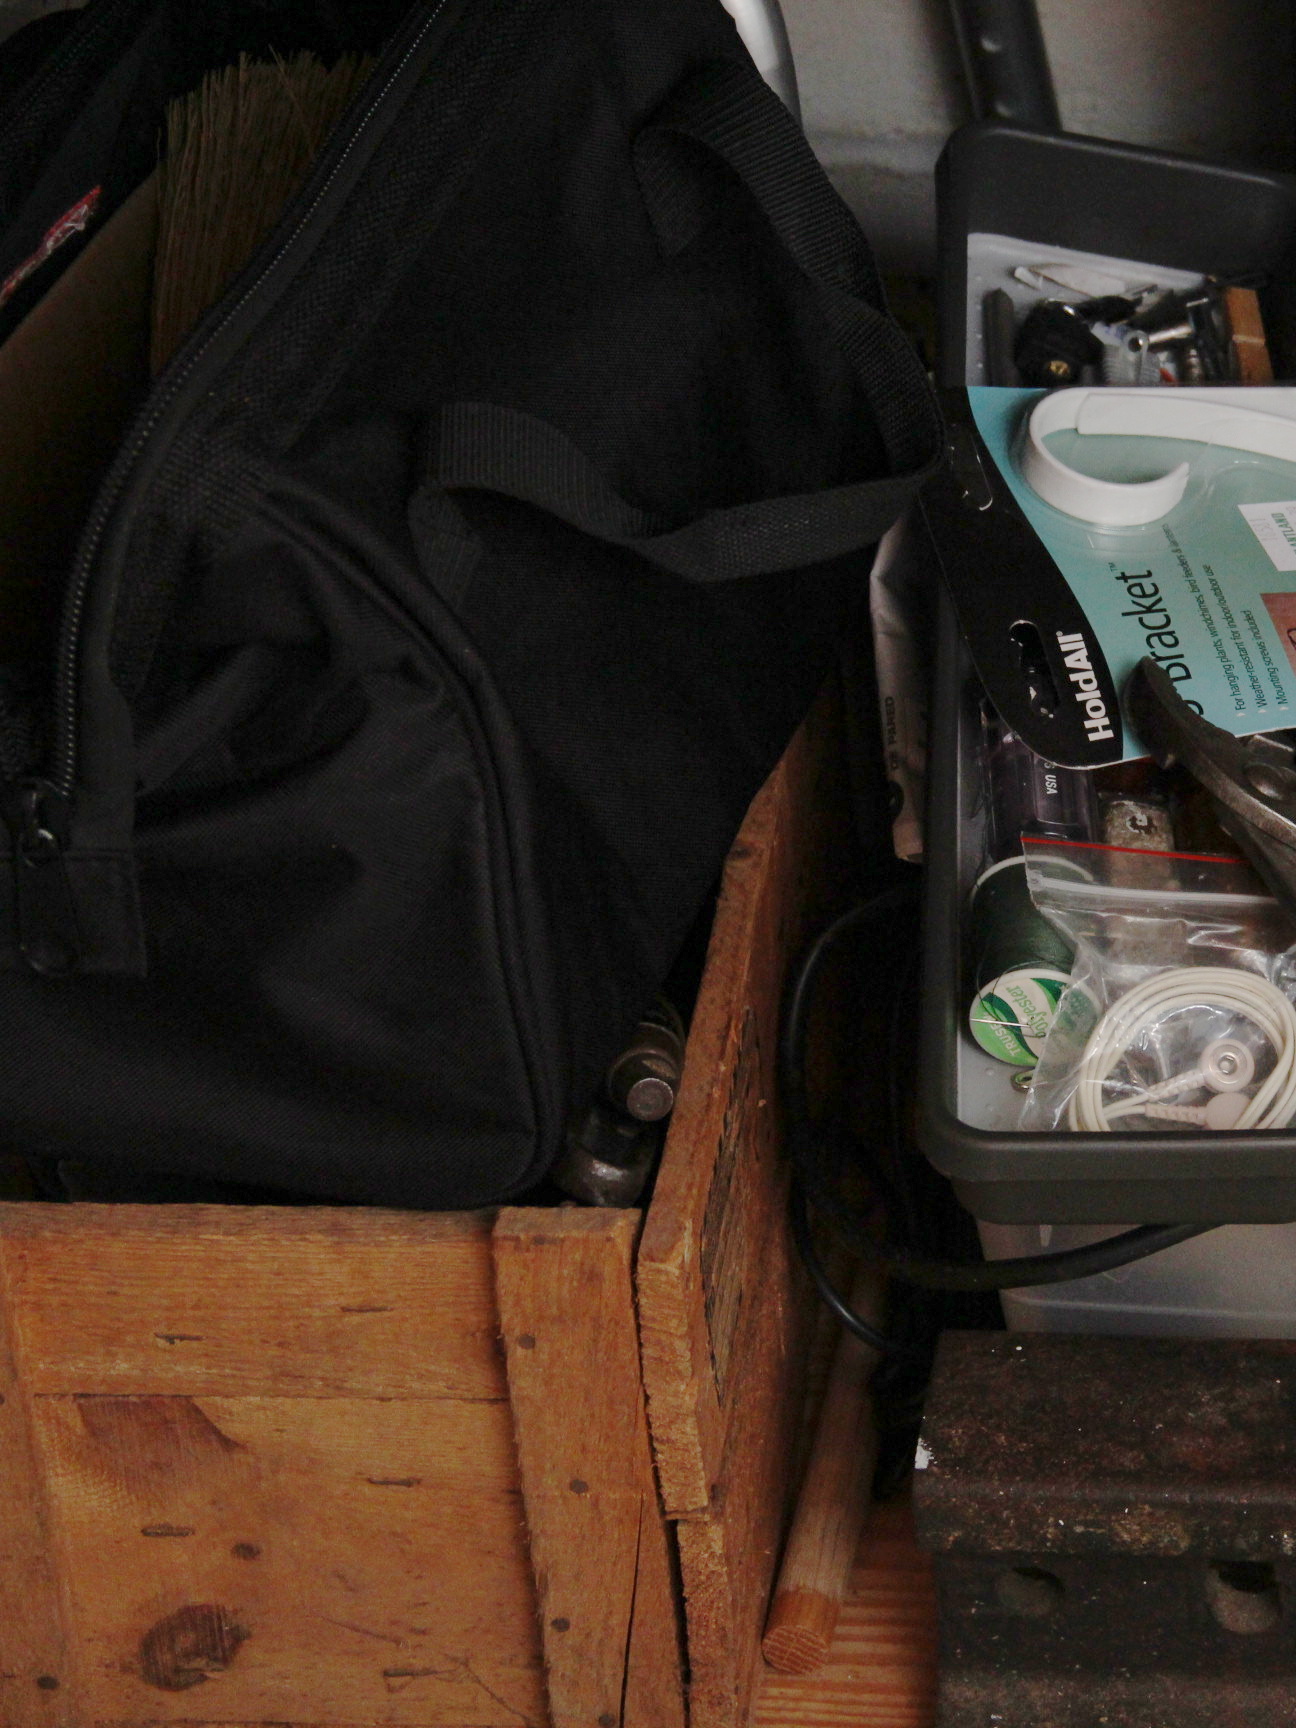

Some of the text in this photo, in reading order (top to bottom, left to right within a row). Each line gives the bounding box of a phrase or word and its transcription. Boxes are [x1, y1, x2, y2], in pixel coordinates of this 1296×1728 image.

[1202, 564, 1214, 576] use
[1229, 630, 1241, 640] for
[1240, 609, 1287, 704] Mounting screws included
[1060, 632, 1113, 742] HoldAll
[1222, 664, 1240, 695] hanging
[1234, 641, 1267, 707] Weather-resistant
[1233, 697, 1246, 710] For
[1044, 773, 1057, 794] USA
